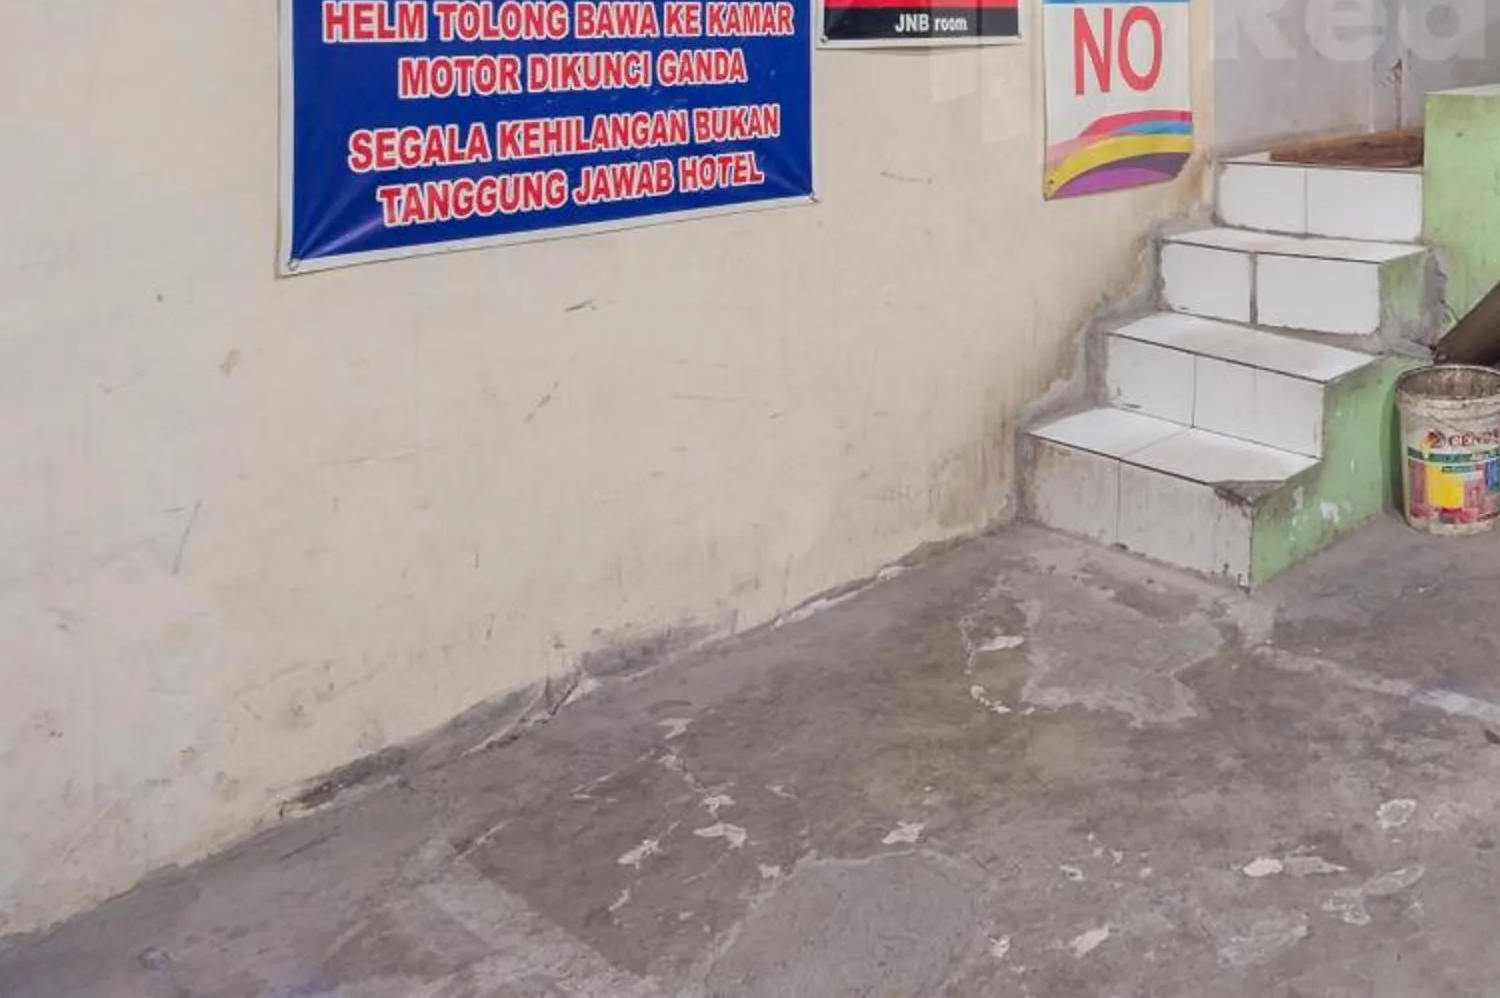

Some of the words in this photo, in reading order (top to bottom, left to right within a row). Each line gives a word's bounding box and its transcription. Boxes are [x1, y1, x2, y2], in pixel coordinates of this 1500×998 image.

[322, 0, 426, 42] HELM
[435, 0, 569, 42] TOLONG
[575, 1, 659, 40] BAWA
[664, 1, 702, 36] KE
[706, 1, 794, 36] KAMAR
[894, 14, 930, 33] JNB
[934, 17, 969, 32] room
[399, 54, 523, 98] MOTOR
[527, 52, 650, 93] DIKUNCI
[656, 48, 748, 86] GANDA
[1073, 5, 1163, 96] NO
[348, 124, 490, 172] SEGALA
[498, 111, 687, 160] KEHILANGAN
[693, 105, 781, 142] BUKAN
[377, 169, 568, 226] TANGGUNG
[573, 160, 673, 205] JAWAB
[677, 152, 765, 191] HOTEL
